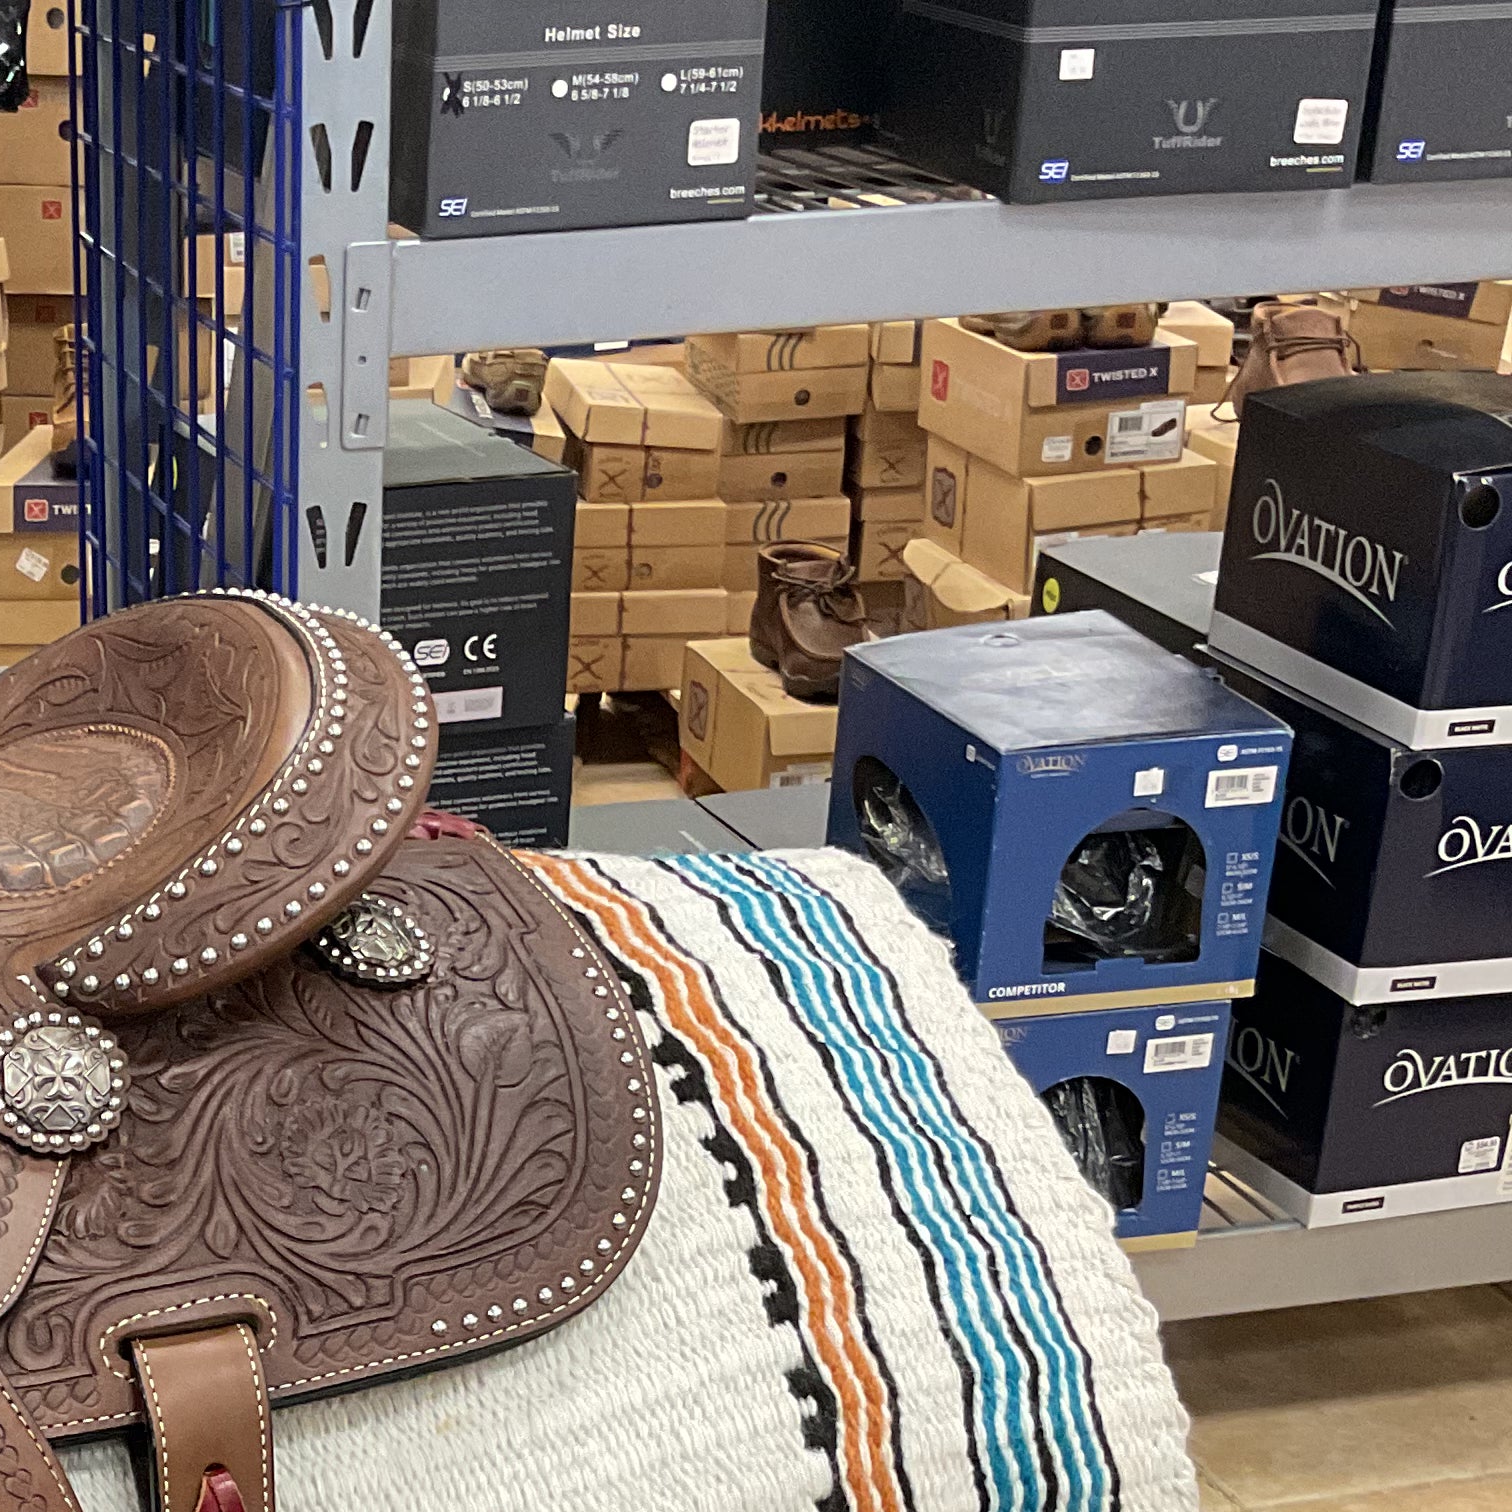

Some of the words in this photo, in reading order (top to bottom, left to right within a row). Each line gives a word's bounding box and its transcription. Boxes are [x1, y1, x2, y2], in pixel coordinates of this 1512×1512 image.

[544, 25, 601, 43] Helmet
[607, 24, 641, 39] Size
[1396, 141, 1426, 160] SEI
[1038, 159, 1070, 180] SEI
[1269, 154, 1345, 168] breeches.com
[669, 185, 746, 199] breeches.com
[439, 198, 468, 217] SEI
[1092, 368, 1147, 383] TWISTED
[1149, 366, 1159, 377] X
[1252, 478, 1404, 602] OVATION
[415, 643, 450, 662] SEI
[463, 633, 498, 661] CE
[988, 982, 1066, 999] COMPETITOR
